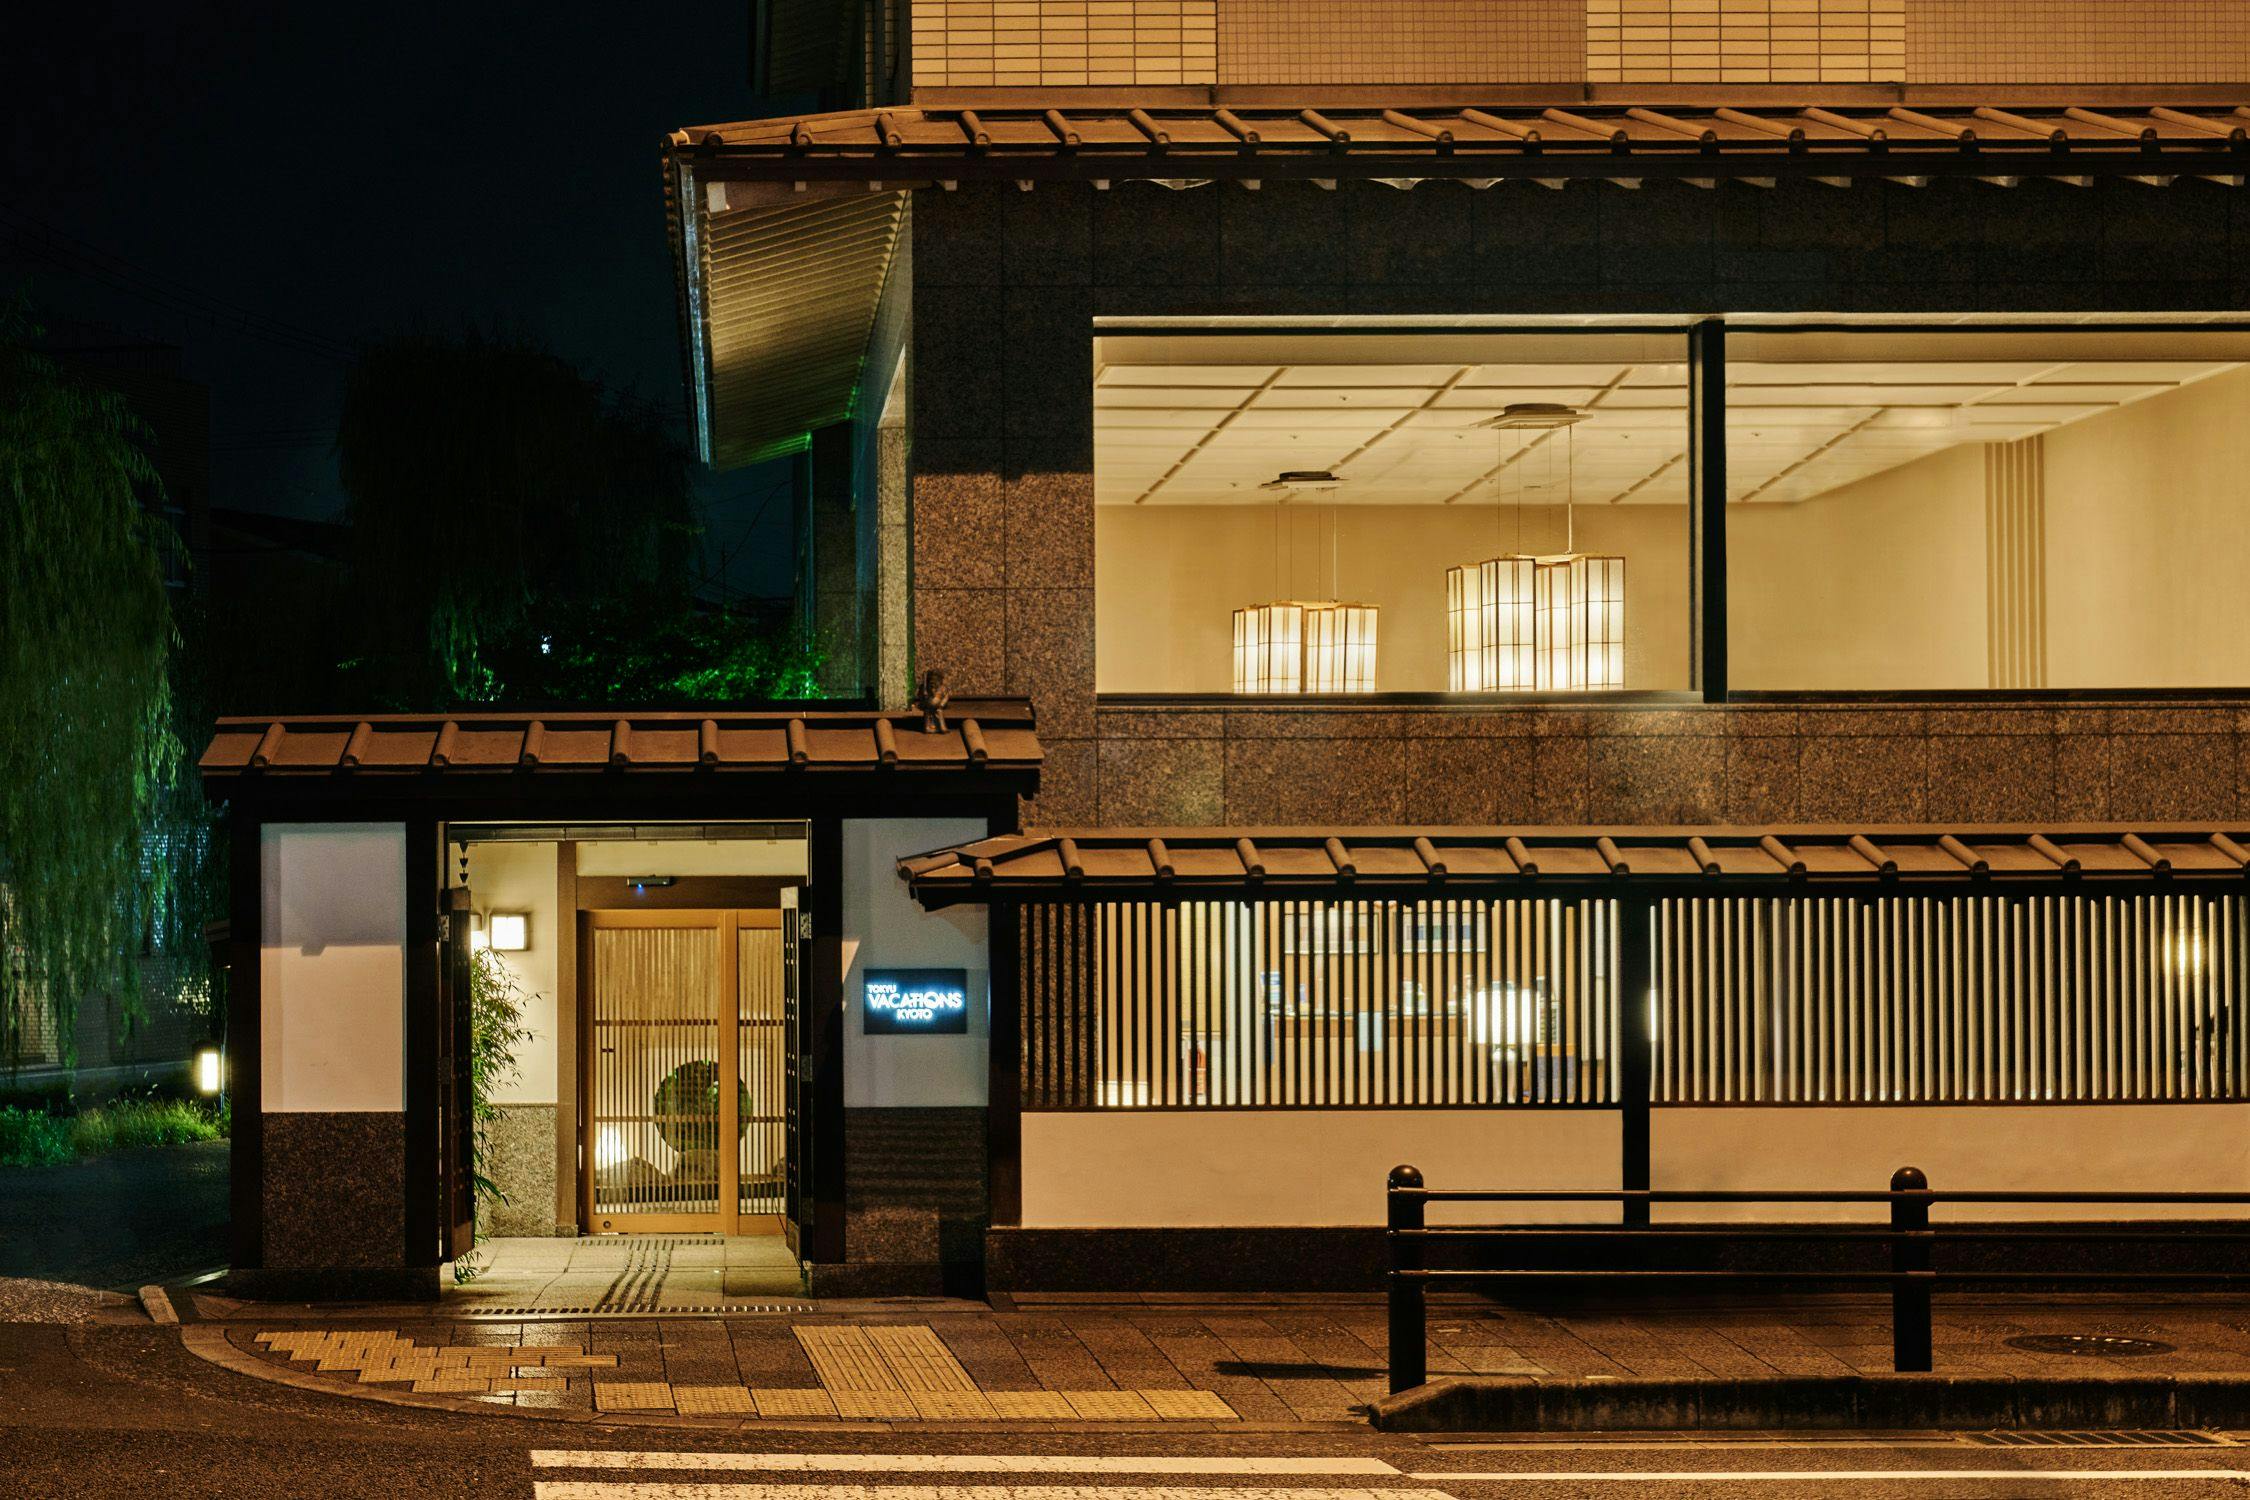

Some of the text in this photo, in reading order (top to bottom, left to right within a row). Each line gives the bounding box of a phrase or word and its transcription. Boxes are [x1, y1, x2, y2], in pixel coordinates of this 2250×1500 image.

[867, 984, 897, 993] TOKYU
[867, 991, 964, 1009] VACATIONS
[896, 1008, 933, 1020] KYOTO
